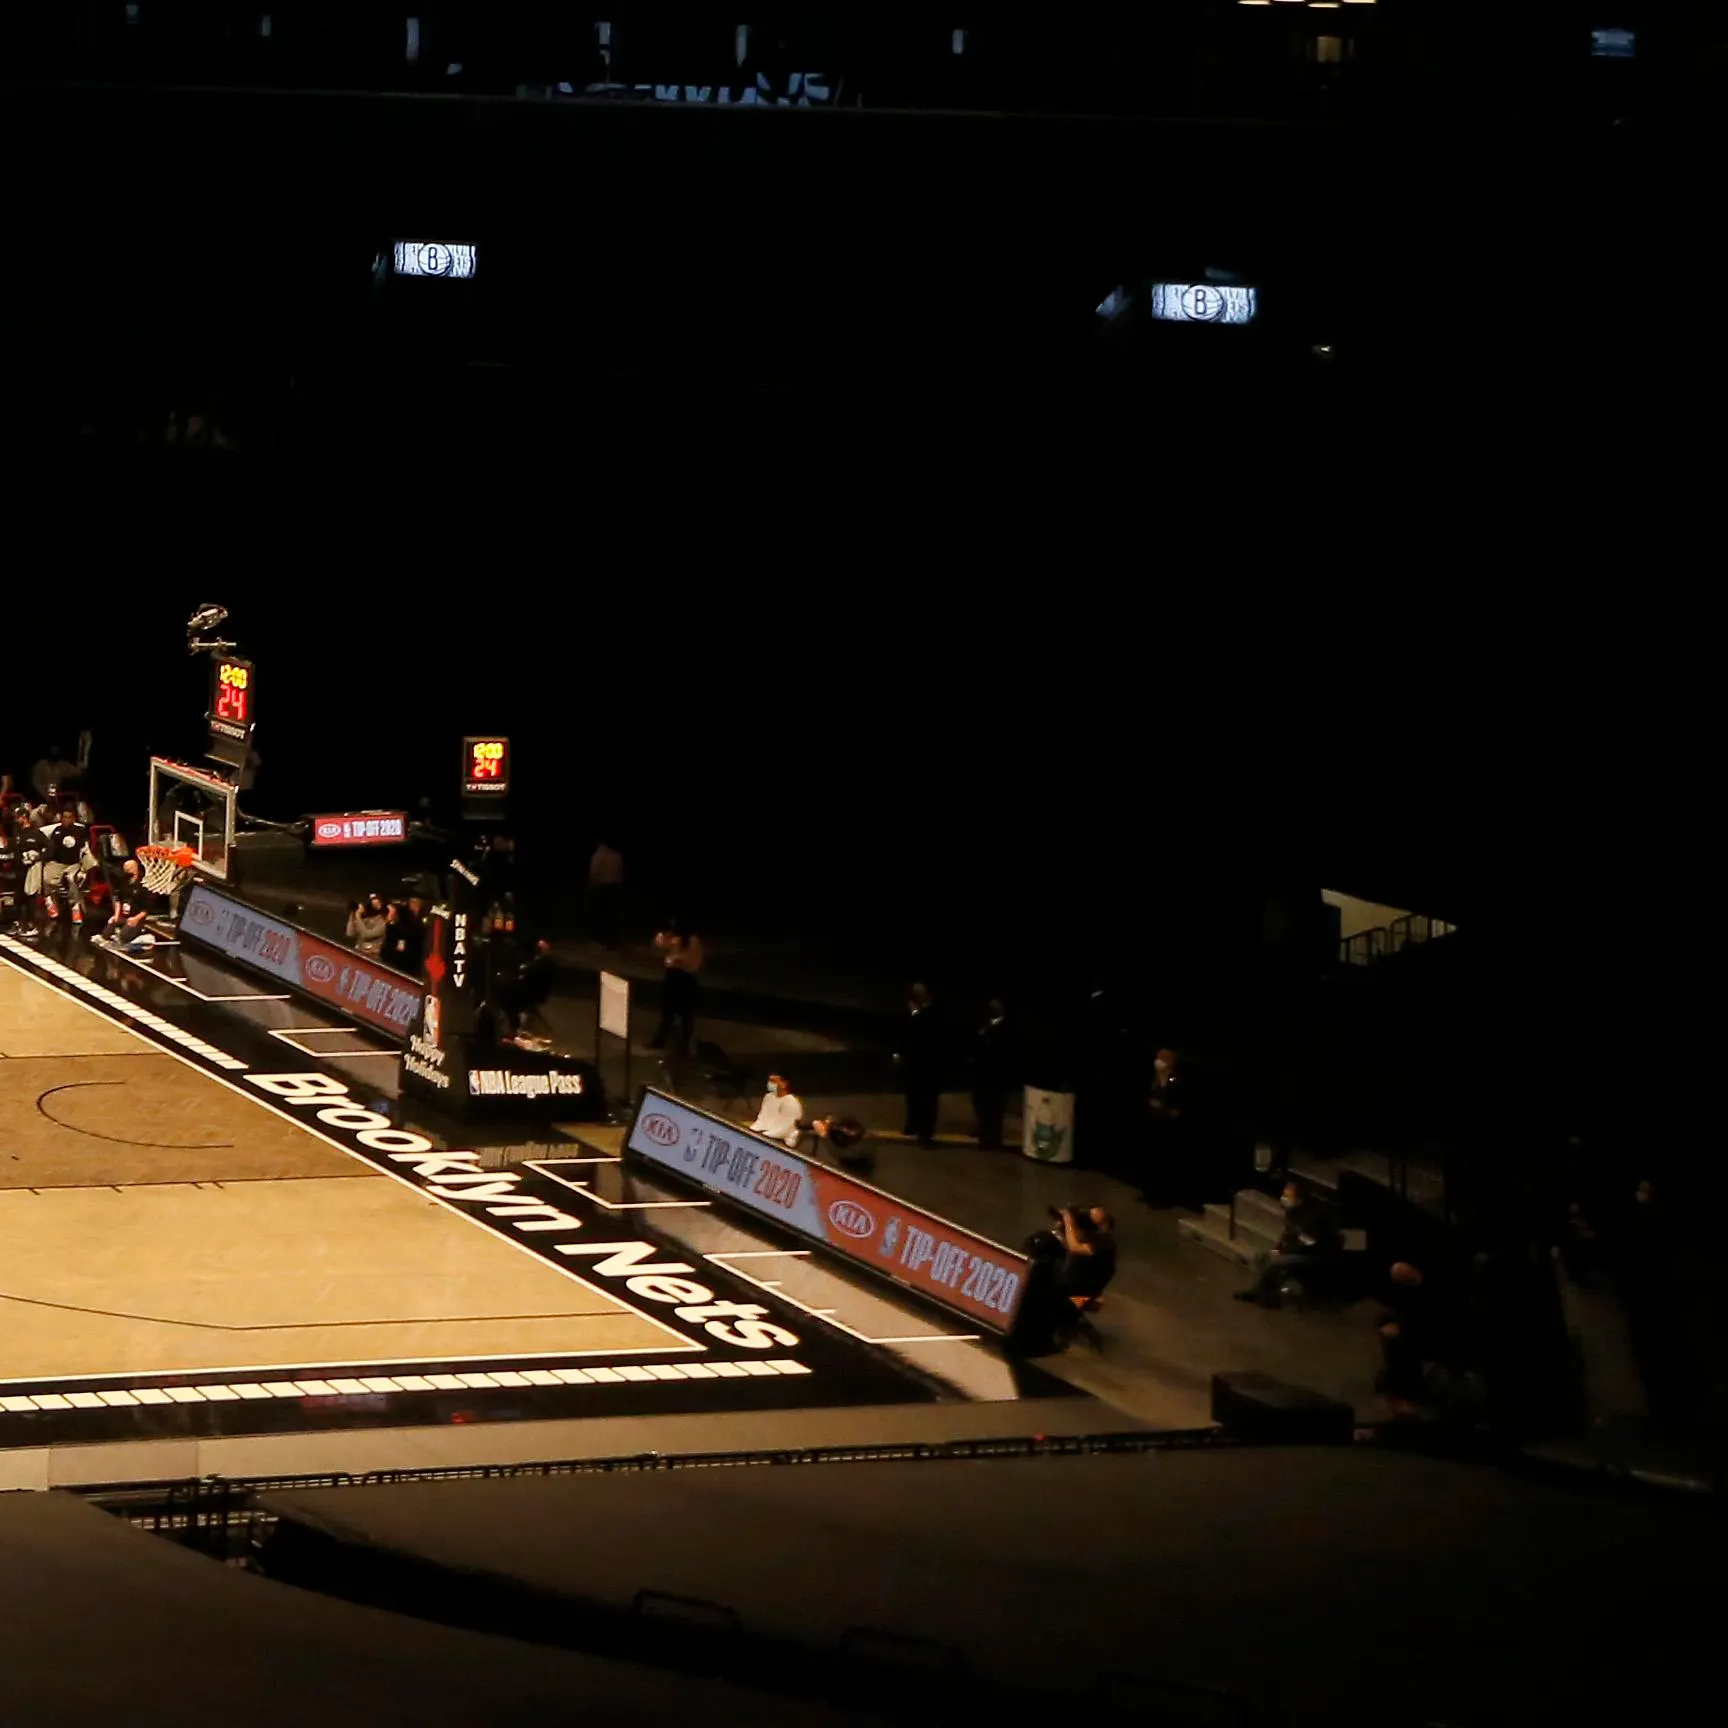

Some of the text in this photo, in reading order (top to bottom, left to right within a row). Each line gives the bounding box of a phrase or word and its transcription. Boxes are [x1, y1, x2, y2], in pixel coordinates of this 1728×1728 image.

[218, 684, 246, 719] 24
[473, 759, 498, 778] 24
[453, 960, 465, 987] TV
[480, 1070, 582, 1099] NBA League Pass
[753, 1160, 804, 1210] 2020
[243, 1071, 799, 1350] Brooklyn Nets
[962, 1256, 1019, 1313] 2020
